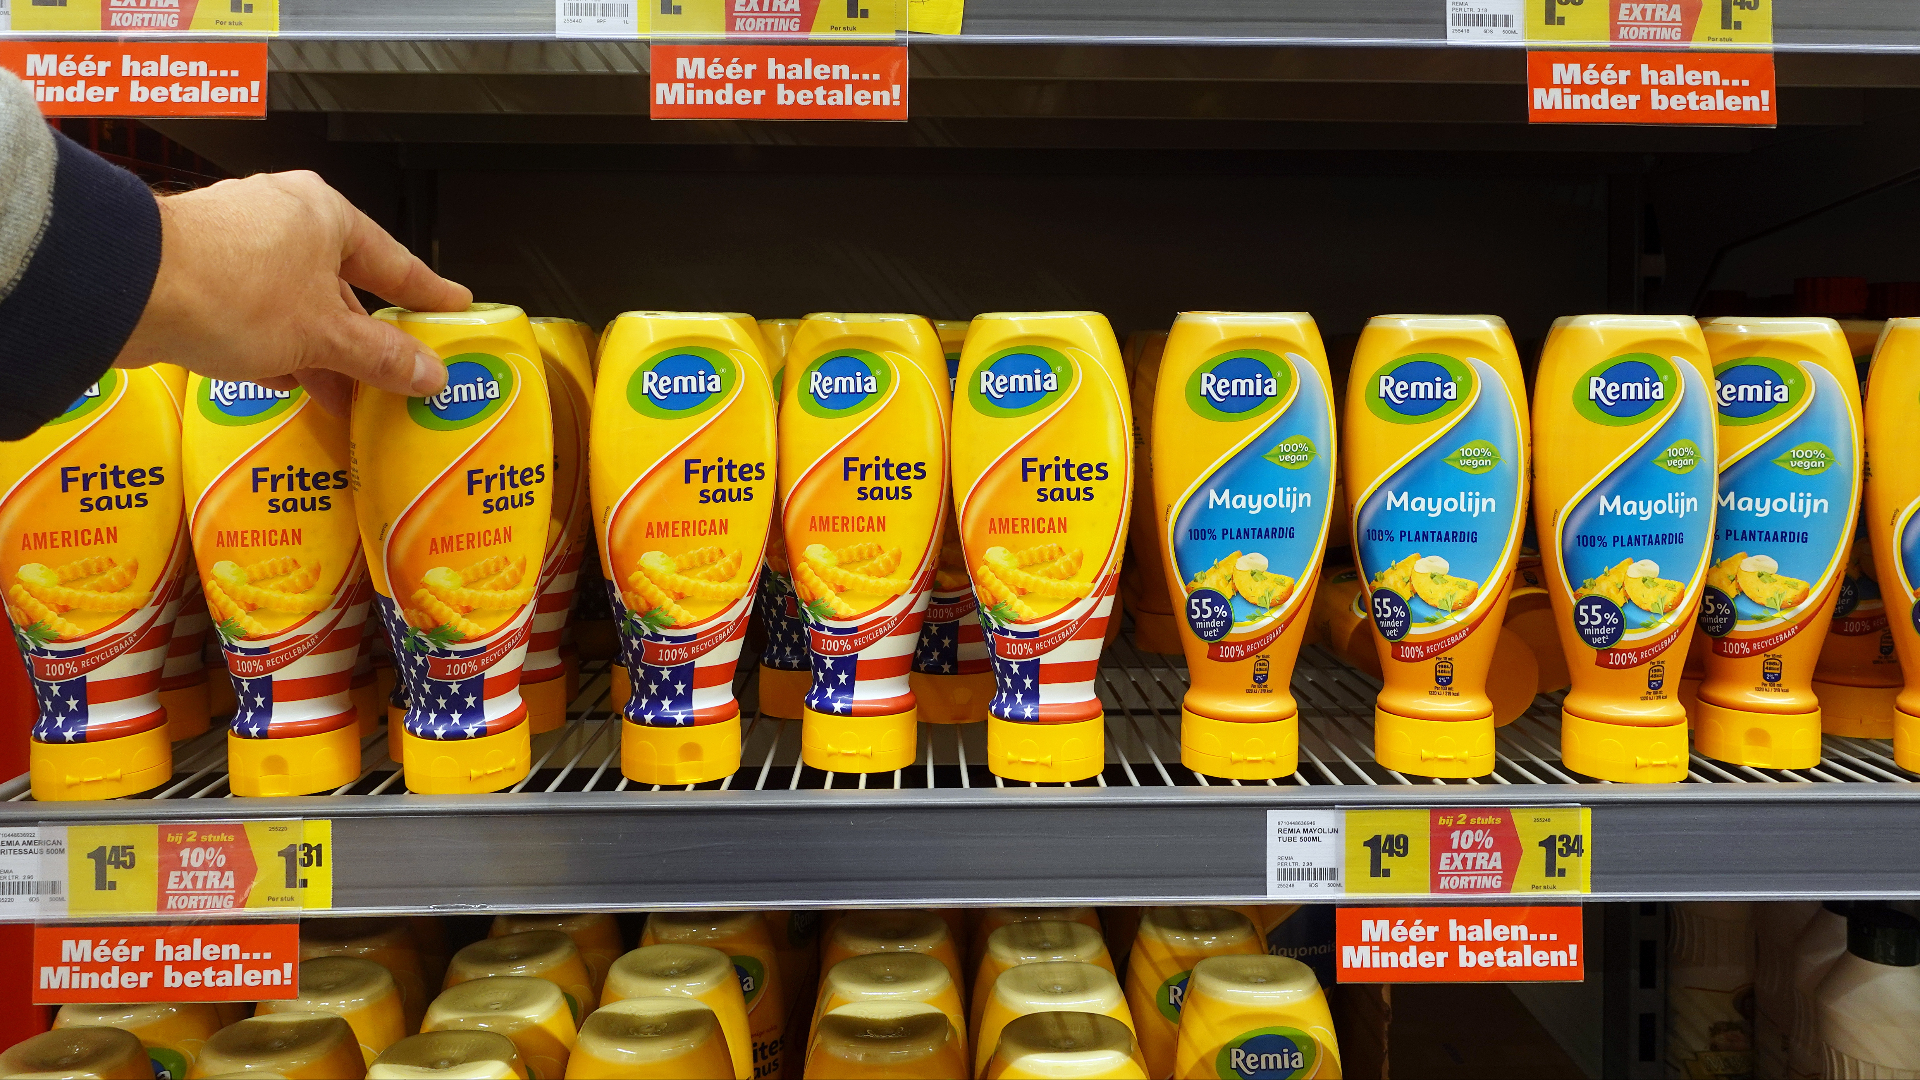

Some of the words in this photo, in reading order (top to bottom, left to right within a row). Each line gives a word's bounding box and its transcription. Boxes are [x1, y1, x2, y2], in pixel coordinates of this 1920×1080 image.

[734, 0, 800, 11] EXTRA
[1619, 4, 1682, 21] EXTRA
[111, 13, 179, 27] KORTING
[735, 18, 800, 31] KORTING
[1619, 27, 1682, 40] KORTING
[26, 54, 111, 77] Méér
[121, 54, 240, 77] halen...
[676, 57, 757, 80] Méér
[767, 58, 881, 81] halen...
[1552, 63, 1630, 86] Méér
[1641, 64, 1749, 87] halen...
[129, 80, 260, 103] betalen!
[655, 83, 766, 106] Minder
[777, 84, 901, 106] betalen!
[1533, 88, 1640, 111] Minder
[1650, 89, 1770, 112] betalen!
[642, 370, 722, 399] Remia
[809, 369, 878, 399] Remia
[980, 367, 1058, 398] Remia
[1200, 372, 1277, 402] Remia
[1379, 375, 1457, 404] Remia
[1589, 376, 1664, 406] Remia
[1279, 443, 1308, 453] 100%
[1460, 448, 1491, 457] 100%
[1667, 447, 1694, 457] 100%
[1790, 449, 1825, 459] 100%
[1279, 453, 1308, 464] vegan
[1460, 458, 1491, 468] vegan
[1667, 458, 1693, 468] vegan
[1790, 460, 1825, 470] vegan
[61, 463, 165, 493] Frites
[684, 457, 765, 485] Frites
[843, 456, 927, 482] Frites
[1021, 457, 1109, 483] Frites
[251, 465, 349, 493] Frites
[467, 462, 545, 496] Frites
[699, 484, 754, 504] saus
[857, 484, 913, 501] saus
[1036, 484, 1094, 502] saus
[1209, 487, 1311, 514] Mayolijn
[80, 493, 148, 513] saus
[268, 494, 332, 513] saus
[482, 491, 535, 515] saus
[1386, 491, 1495, 517] Mayolijn
[1599, 492, 1698, 520] Mayolijn
[1718, 491, 1829, 518] Mayolijn
[645, 519, 728, 539] AMERICAN
[809, 516, 886, 533] AMERICAN
[988, 517, 1067, 535] AMERICAN
[1189, 528, 1216, 540] 100%
[1222, 527, 1294, 540] PLANTAARDIG
[21, 526, 118, 551] AMERICAN
[216, 529, 302, 548] AMERICAN
[429, 526, 512, 556] AMERICAN
[1367, 529, 1394, 541] 100%
[1400, 530, 1477, 543] PLANTAARDIG
[1576, 534, 1607, 547] 100%
[1613, 532, 1683, 547] PLANTAARDIG
[1726, 529, 1808, 543] PLANTAARDIG
[927, 603, 953, 618] 100%
[1191, 598, 1227, 619] 55%
[1374, 598, 1405, 618] 55%
[1579, 605, 1618, 625] 55%
[1196, 619, 1225, 628] minder
[1380, 619, 1403, 627] minder
[1701, 615, 1728, 623] minder
[1584, 626, 1616, 634] minder
[657, 646, 688, 661] 100%
[821, 637, 851, 652] 100%
[1006, 640, 1032, 656] 100%
[1220, 645, 1244, 658] 100%
[1400, 646, 1424, 658] 100%
[1723, 641, 1750, 654] 100%
[236, 658, 264, 673] 100%
[1609, 651, 1637, 665] 100%
[45, 659, 78, 676] 100%
[445, 659, 478, 676] 100%
[1438, 816, 1453, 827] bij
[1457, 814, 1466, 824] 2
[1469, 815, 1501, 825] stuks
[167, 833, 182, 844] bij
[186, 831, 196, 842] 2
[201, 833, 235, 843] stuks
[1450, 829, 1493, 849] 10%
[179, 847, 226, 868] 10%
[1439, 852, 1502, 870] EXTRA
[167, 871, 235, 889] EXTRA
[1440, 876, 1502, 890] KORTING
[167, 895, 235, 909] KORTING
[1361, 919, 1438, 942] Méér
[1449, 919, 1557, 942] halen...
[62, 939, 144, 963] Méér
[155, 938, 272, 962] halen...
[1342, 945, 1448, 968] Minder
[1459, 944, 1577, 968] betalen!
[39, 966, 153, 989] Minder
[164, 963, 293, 988] betalen!
[1230, 1047, 1304, 1072] Remia
